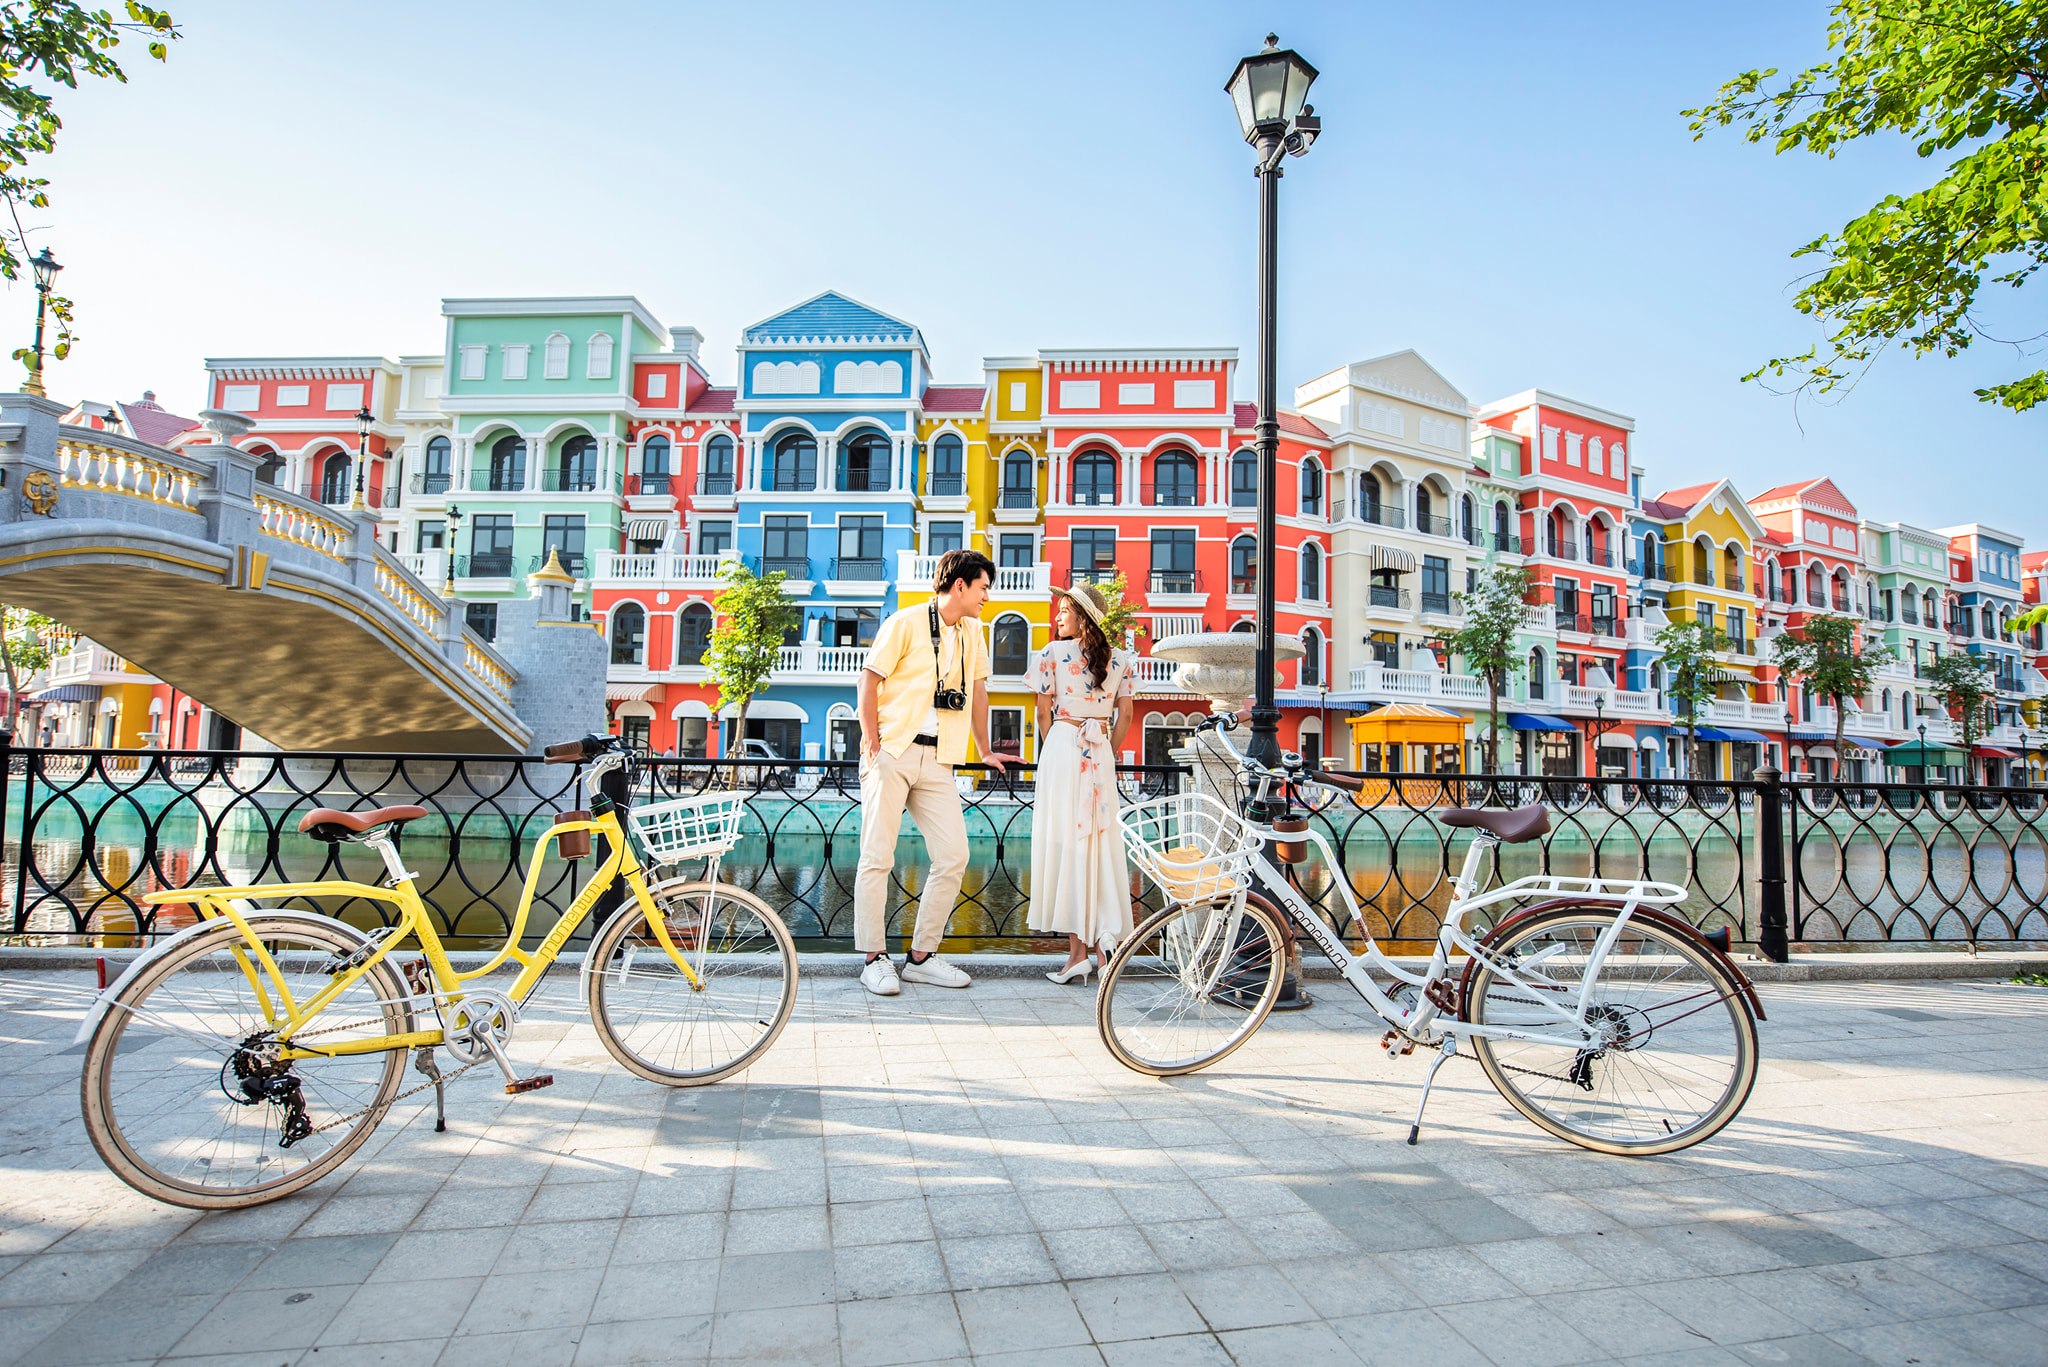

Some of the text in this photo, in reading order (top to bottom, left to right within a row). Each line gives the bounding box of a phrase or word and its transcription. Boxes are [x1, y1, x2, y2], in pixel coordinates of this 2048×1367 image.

[540, 883, 601, 959] momentum
[1282, 898, 1348, 969] momentum
[1507, 1032, 1526, 1040] Giant
